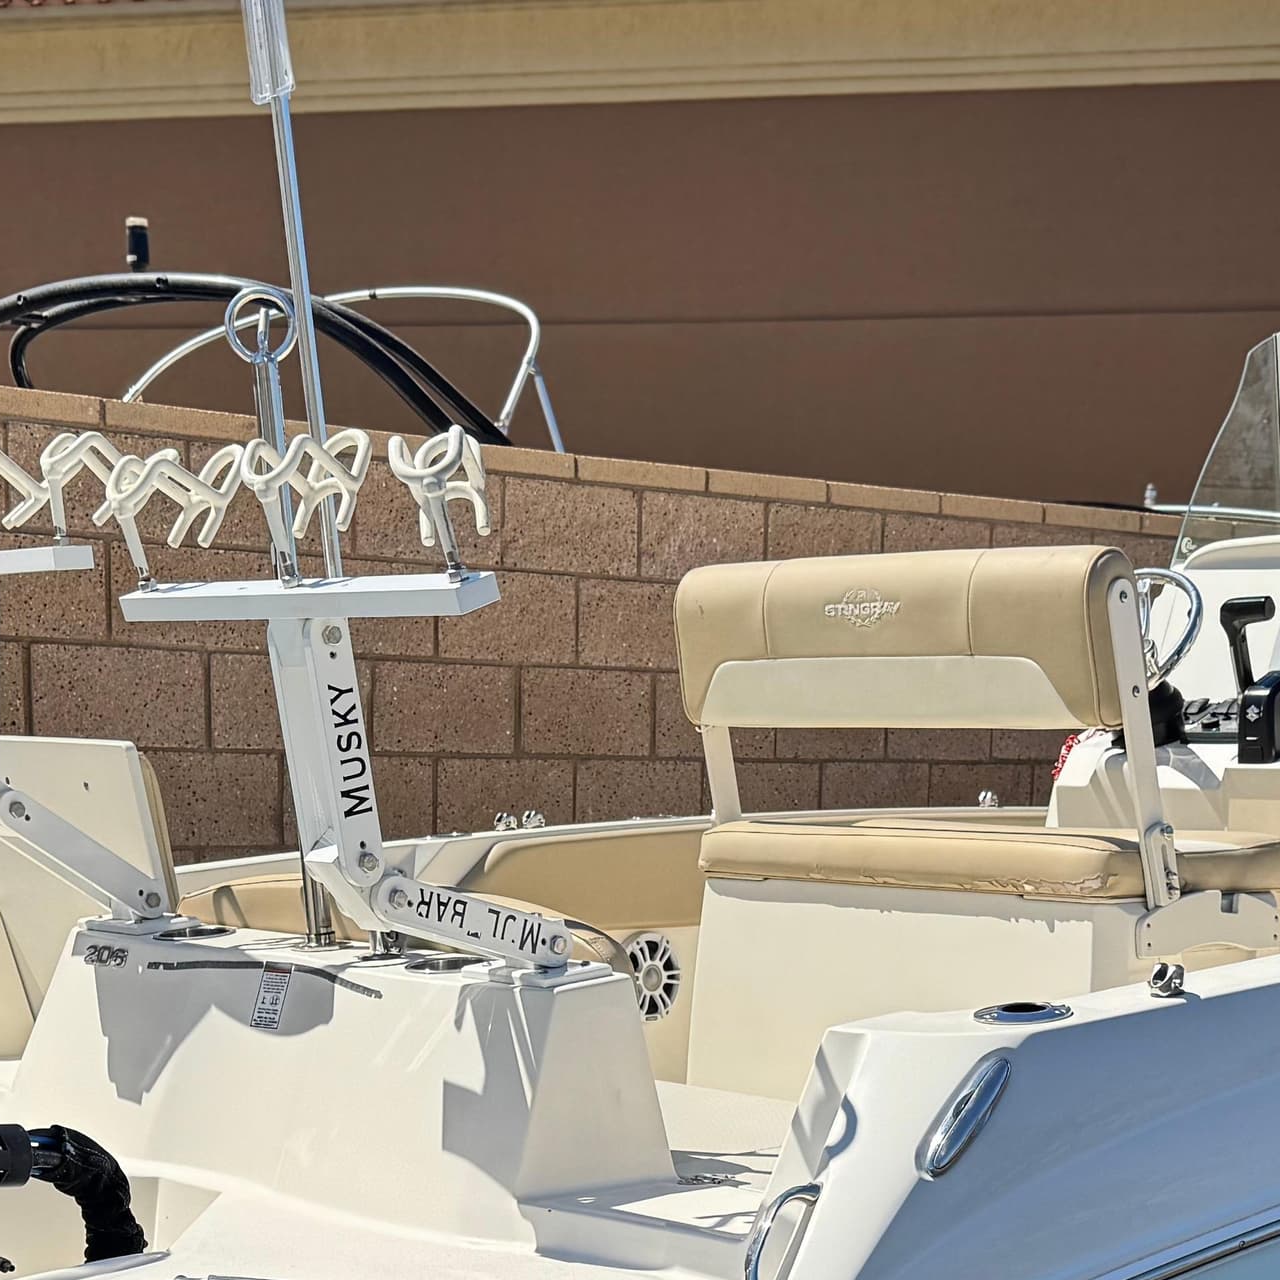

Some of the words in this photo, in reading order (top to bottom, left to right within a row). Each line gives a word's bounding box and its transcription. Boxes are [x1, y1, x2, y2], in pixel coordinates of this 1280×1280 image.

[327, 683, 374, 819] MUSKY
[416, 888, 470, 928] BAR
[84, 944, 129, 968] 206
